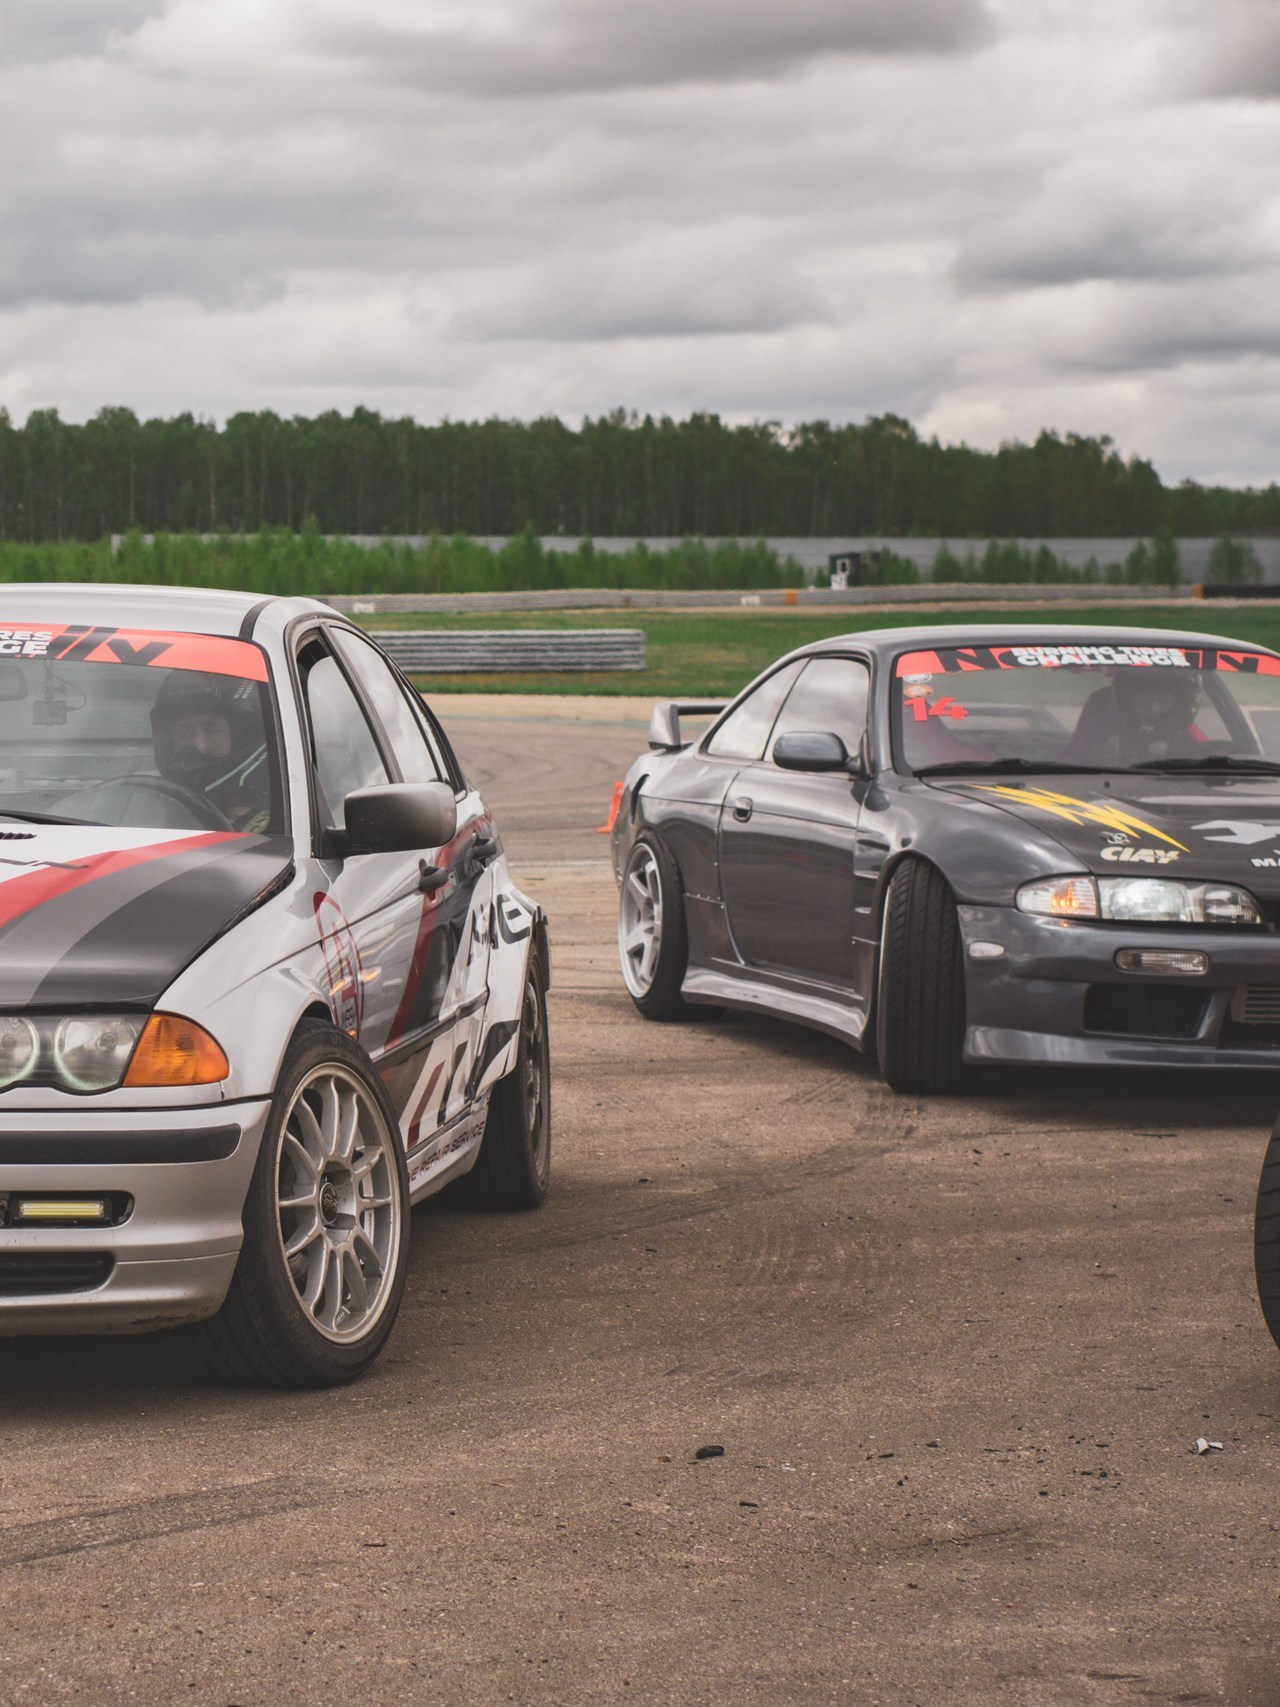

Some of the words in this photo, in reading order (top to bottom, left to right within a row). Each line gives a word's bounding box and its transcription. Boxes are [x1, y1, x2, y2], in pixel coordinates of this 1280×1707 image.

[1011, 646, 1116, 657] BURNING
[1117, 646, 1185, 657] TIRES
[1017, 654, 1191, 667] CHALLENGE
[903, 696, 969, 722] 14
